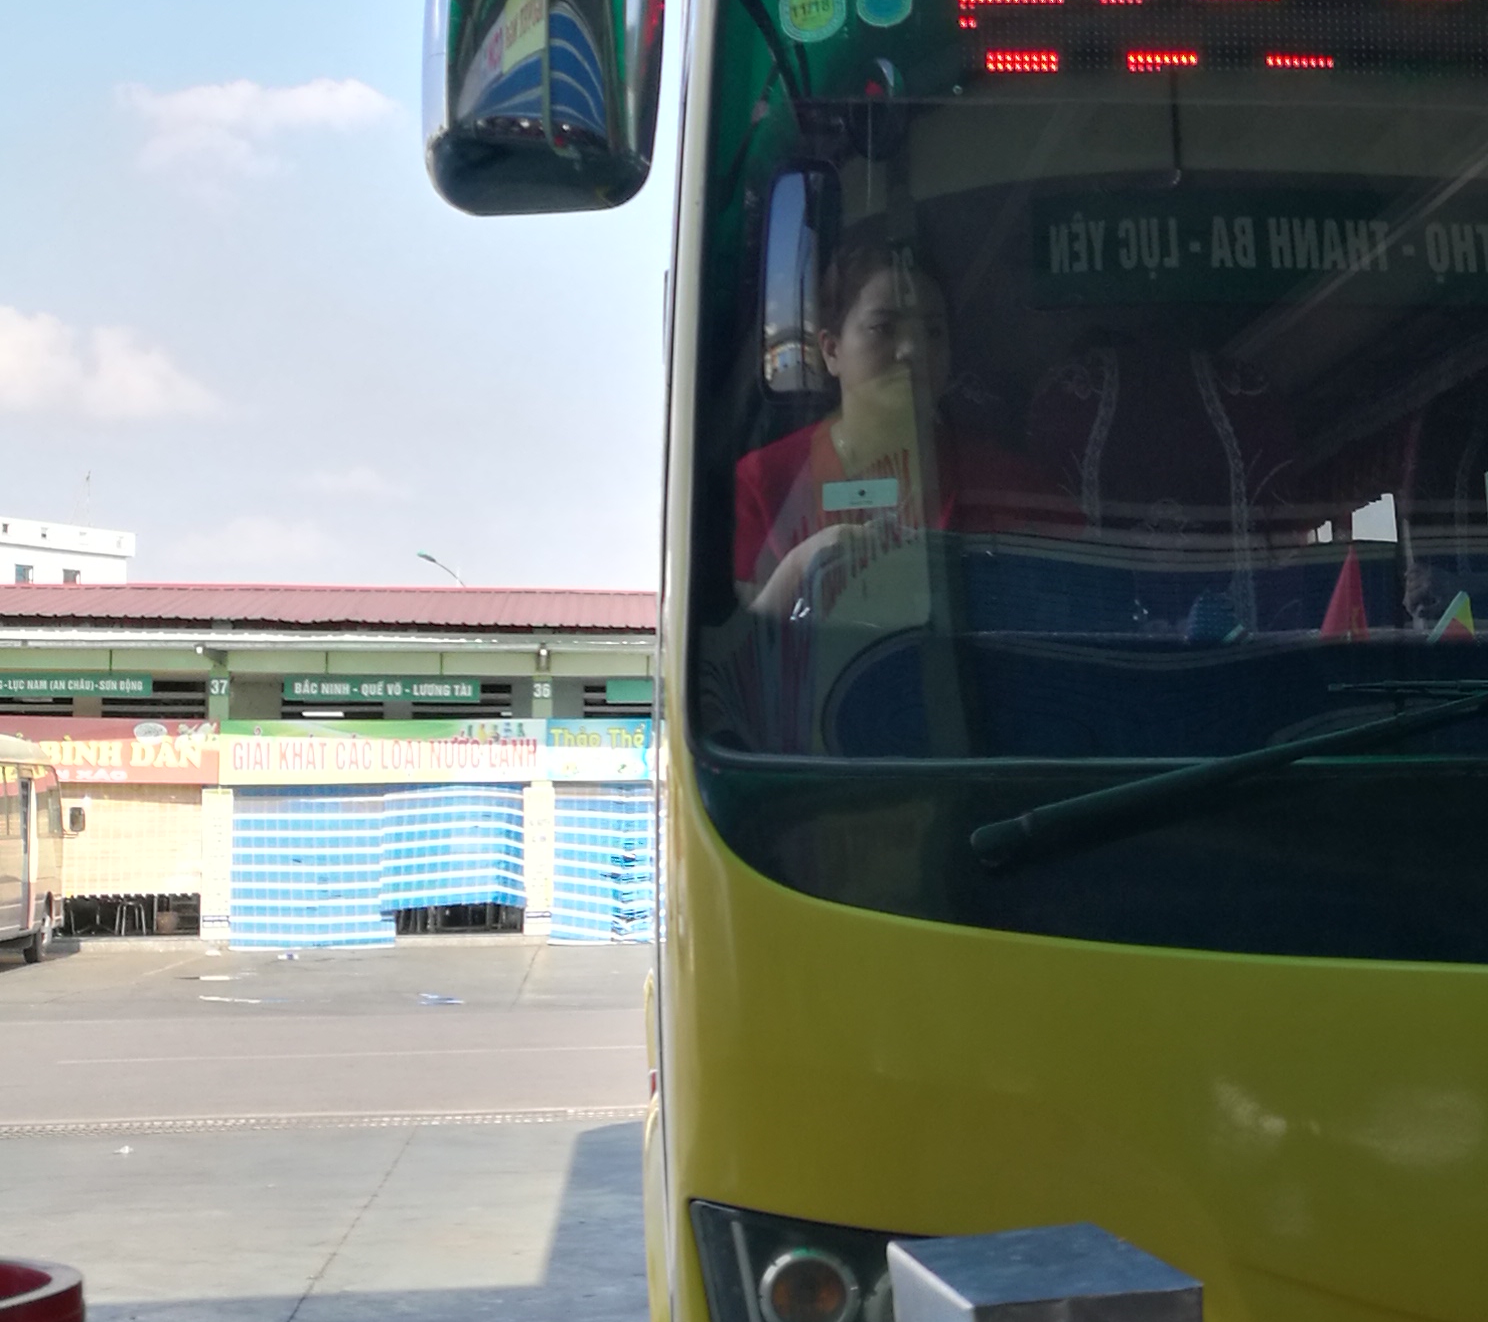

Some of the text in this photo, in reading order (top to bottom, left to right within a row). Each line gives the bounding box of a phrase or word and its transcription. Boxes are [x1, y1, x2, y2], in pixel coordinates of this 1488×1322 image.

[27, 679, 47, 690] NAM
[50, 679, 66, 691] (AN
[119, 679, 143, 693] ĐỘNG
[210, 679, 228, 694] 37
[321, 682, 350, 695] NINH
[533, 683, 551, 698] 36
[550, 725, 601, 748] Thảo
[39, 734, 123, 767] BÌNH
[130, 734, 201, 769] DÂN
[232, 726, 271, 771] GIẢI
[278, 733, 328, 771] KHÁT
[335, 733, 373, 771] CÁC
